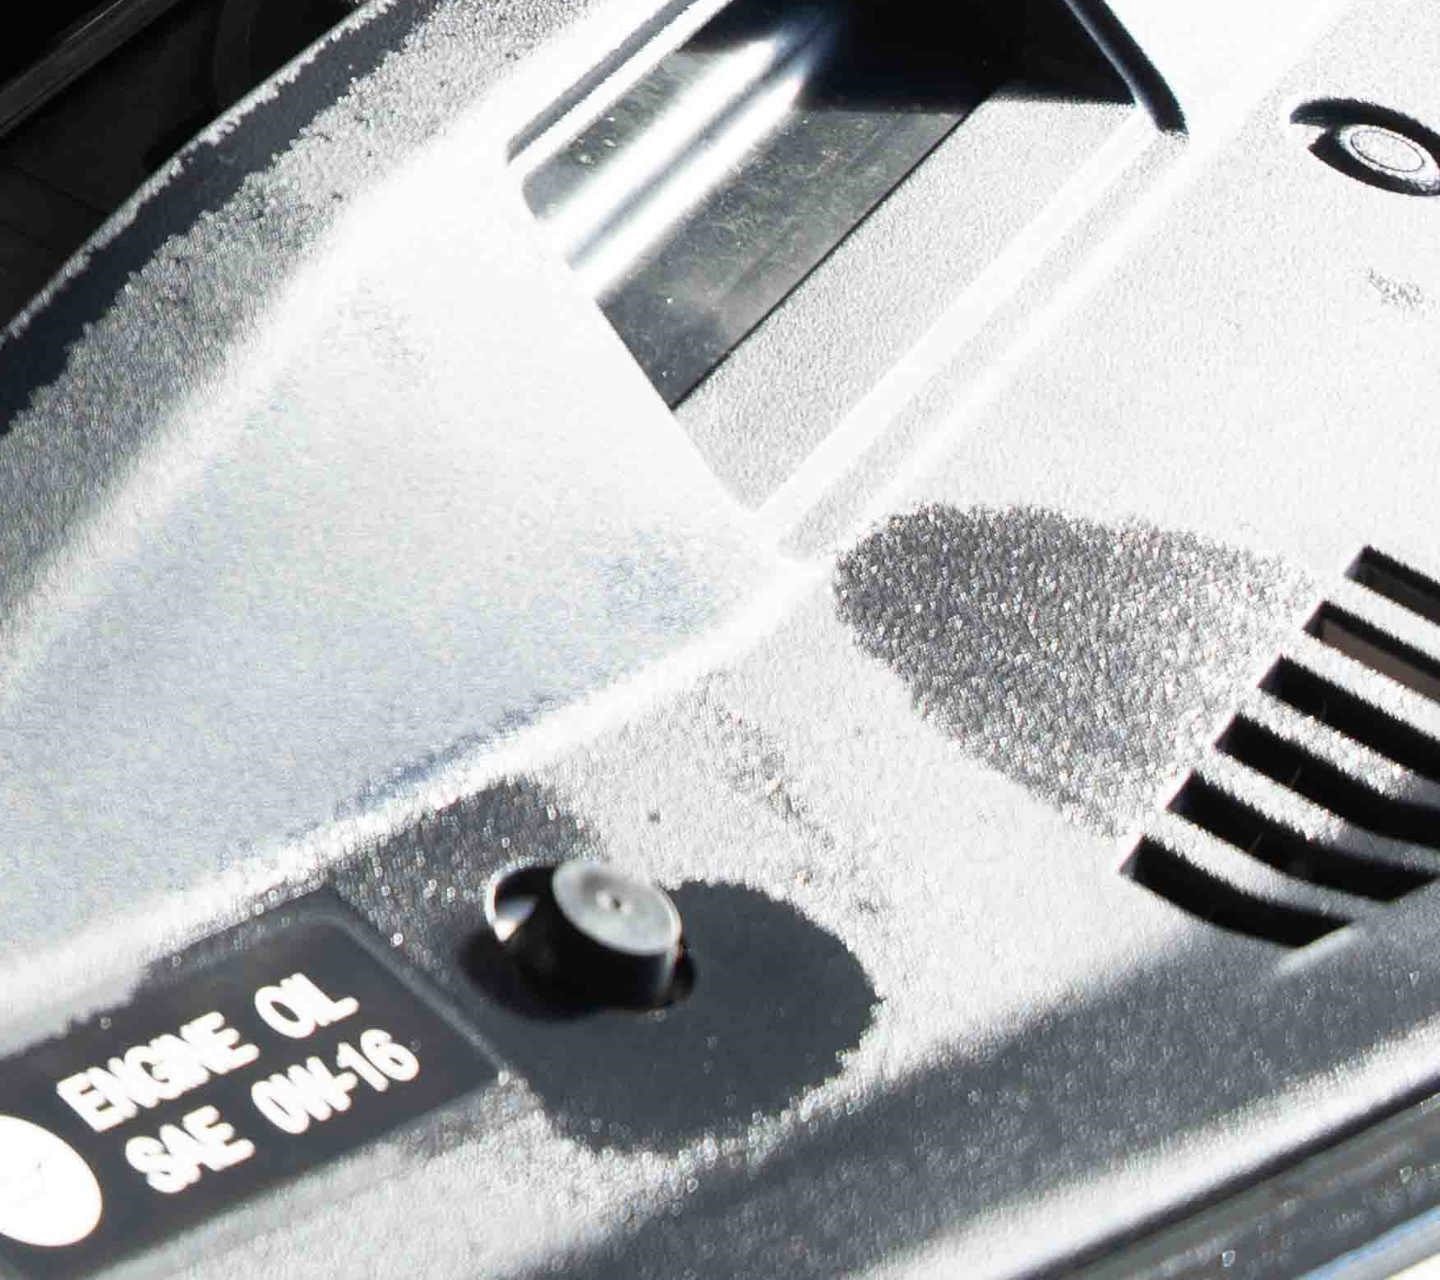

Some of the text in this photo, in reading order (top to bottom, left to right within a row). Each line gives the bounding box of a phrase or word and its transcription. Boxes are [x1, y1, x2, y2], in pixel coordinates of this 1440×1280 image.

[57, 973, 359, 1132] ENGINE OIL
[125, 1029, 419, 1193] SAE 0W-16
